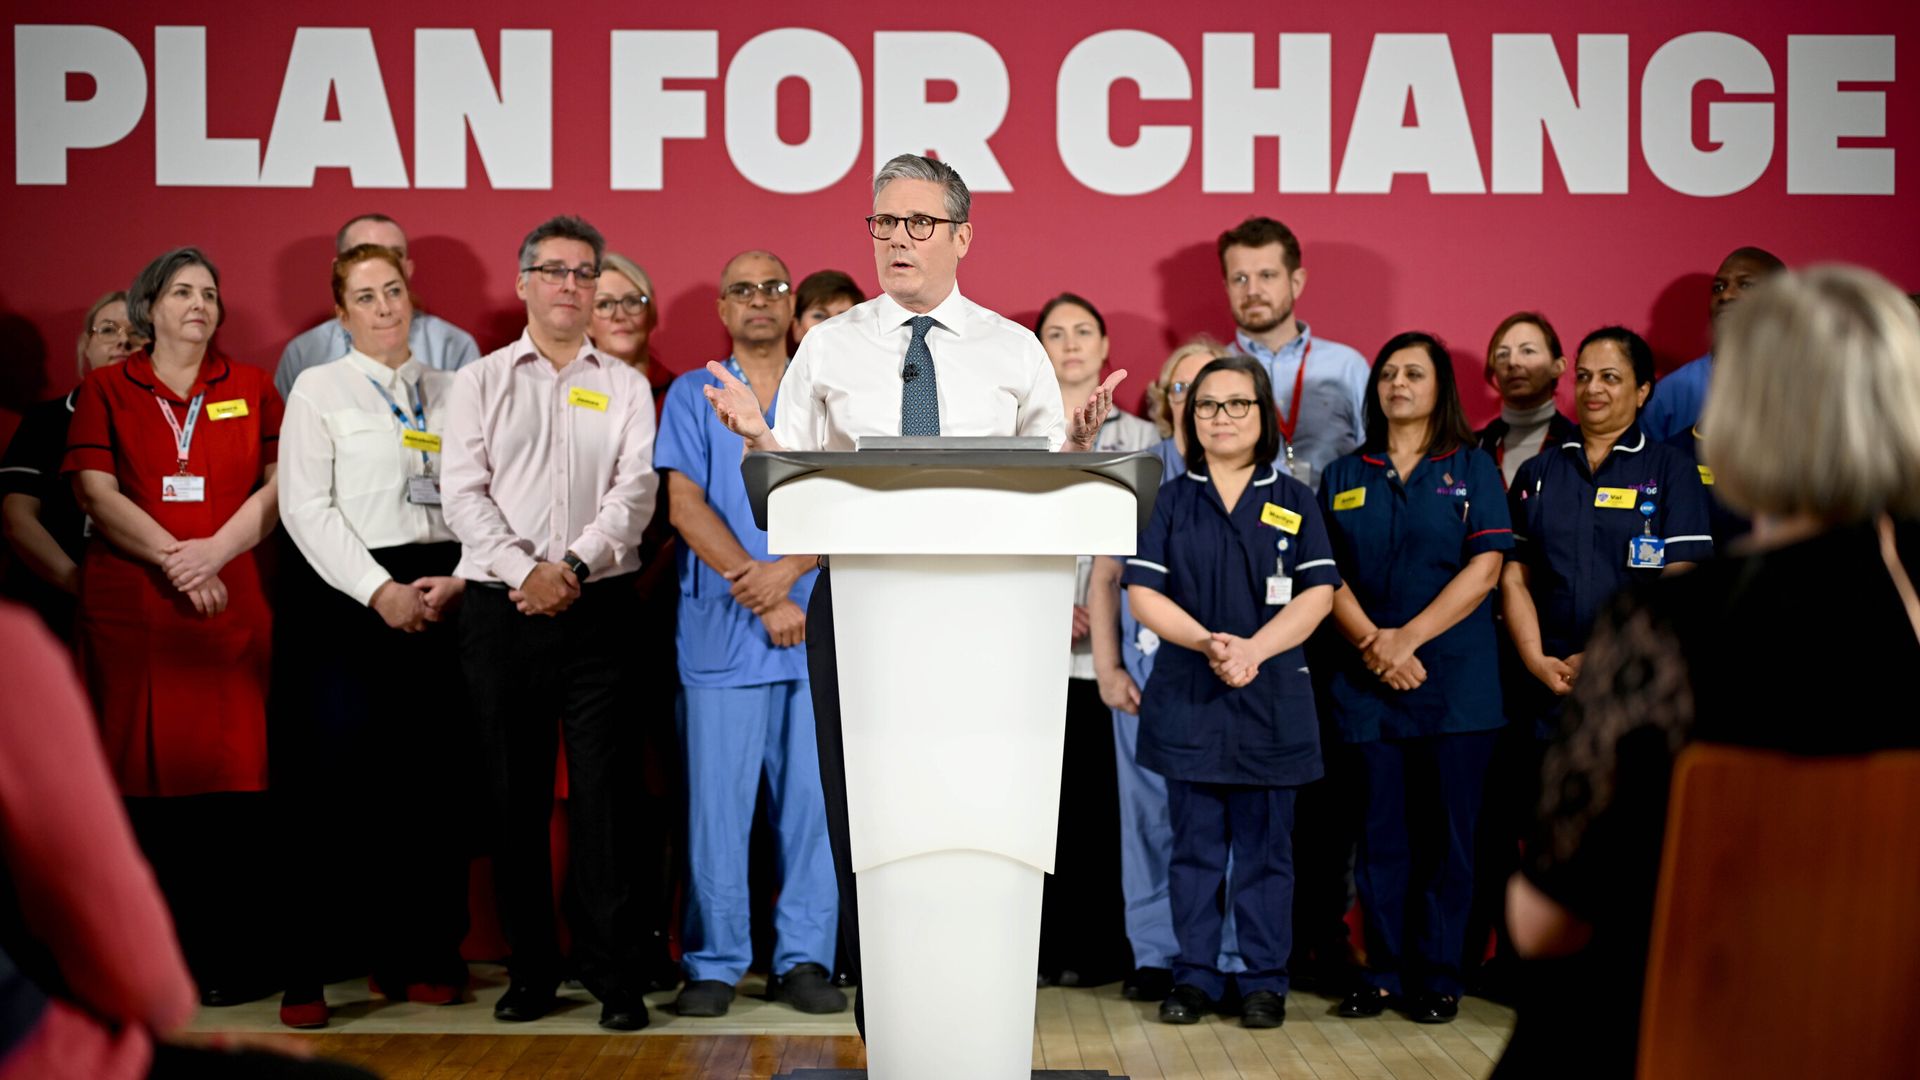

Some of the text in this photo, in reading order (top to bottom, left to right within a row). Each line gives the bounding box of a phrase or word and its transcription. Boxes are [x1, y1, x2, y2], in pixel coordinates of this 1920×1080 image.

[15, 24, 1894, 197] PLAN FOR CHANGE
